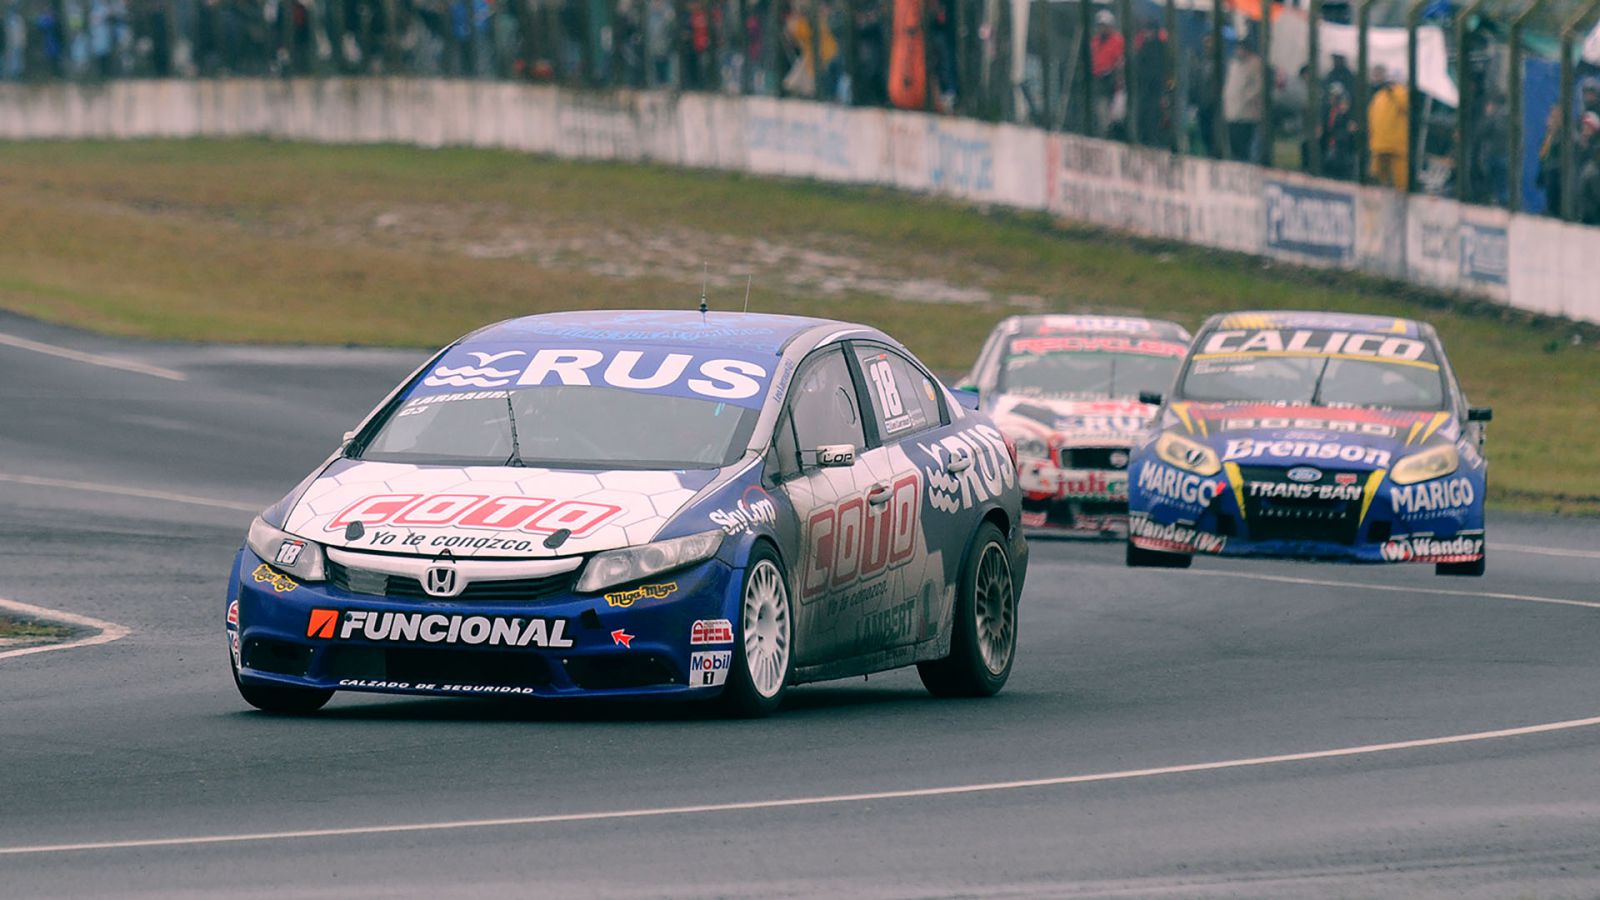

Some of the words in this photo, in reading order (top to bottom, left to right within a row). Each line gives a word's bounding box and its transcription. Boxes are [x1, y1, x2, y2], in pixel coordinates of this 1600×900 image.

[1204, 330, 1426, 361] CALICO
[515, 349, 767, 399] RUS
[870, 360, 903, 418] 18
[1222, 438, 1393, 466] Brenson
[1250, 481, 1362, 500] TRANS-BAN
[1390, 478, 1474, 513] MARIGO
[330, 494, 621, 536] COTO
[370, 531, 396, 546] Yo
[402, 532, 426, 546] te
[431, 534, 534, 553] conozco.
[803, 475, 918, 599] COTO
[1129, 517, 1196, 543] Wander
[276, 543, 302, 564] 18
[1413, 536, 1483, 556] Wander
[340, 611, 573, 647] FUNCIONAL
[692, 654, 730, 671] Mobil
[339, 679, 410, 689] CALZADO
[441, 684, 534, 694] SEGURIDAD
